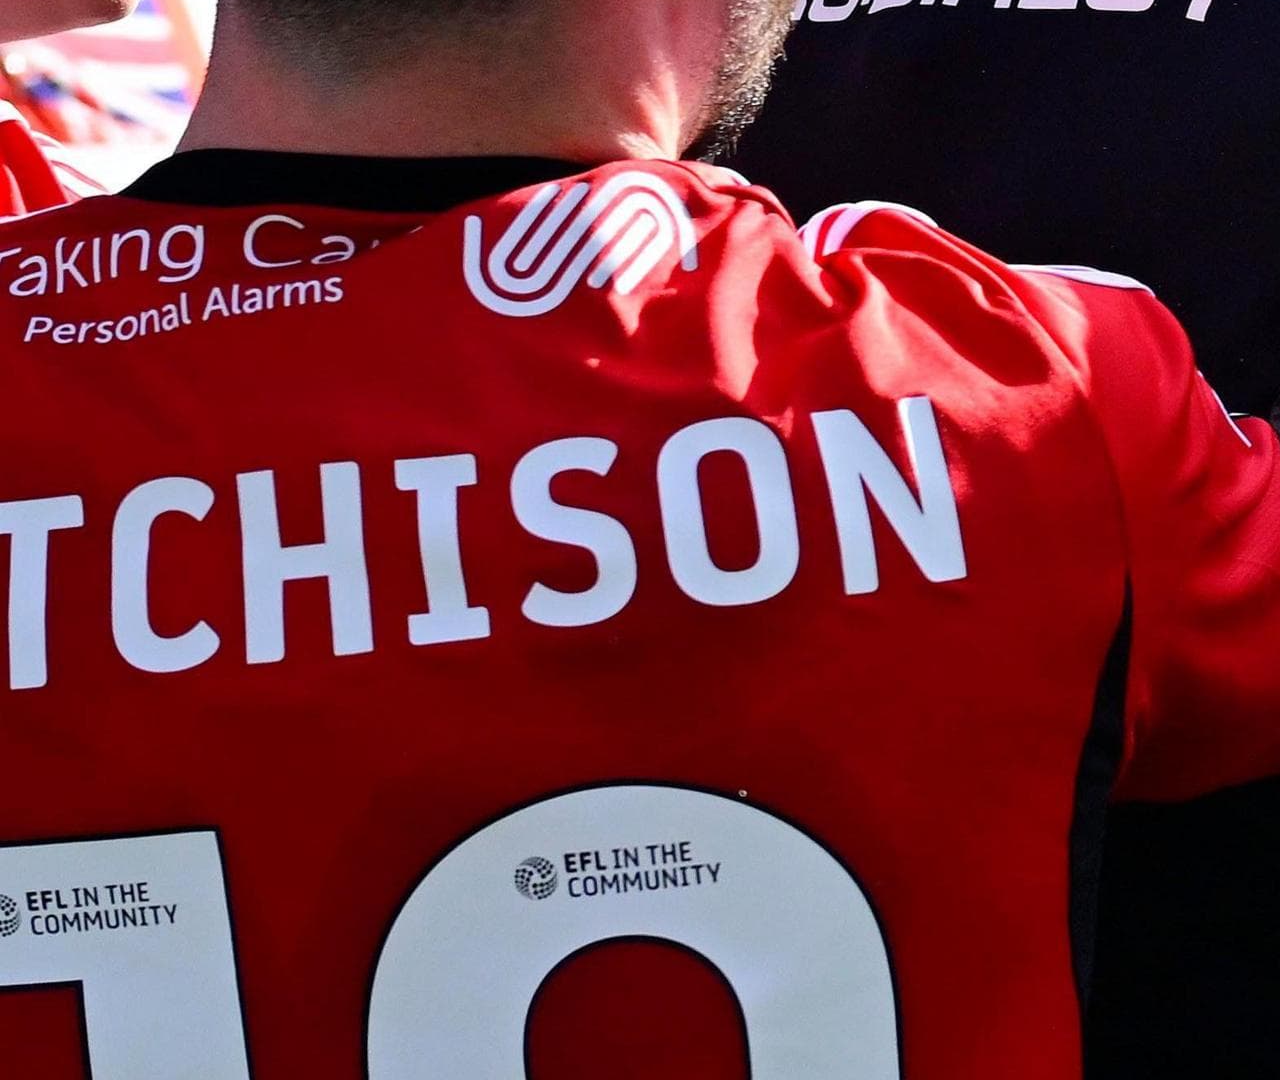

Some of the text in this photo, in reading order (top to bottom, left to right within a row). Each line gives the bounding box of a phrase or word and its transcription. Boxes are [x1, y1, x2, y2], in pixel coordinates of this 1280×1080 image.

[24, 276, 344, 344] Personal Alarms
[563, 841, 692, 873] EFL IN THE
[567, 862, 721, 898] COMMUNITY
[26, 882, 150, 911] EFL IN THE
[31, 904, 178, 935] COMMUNITY
